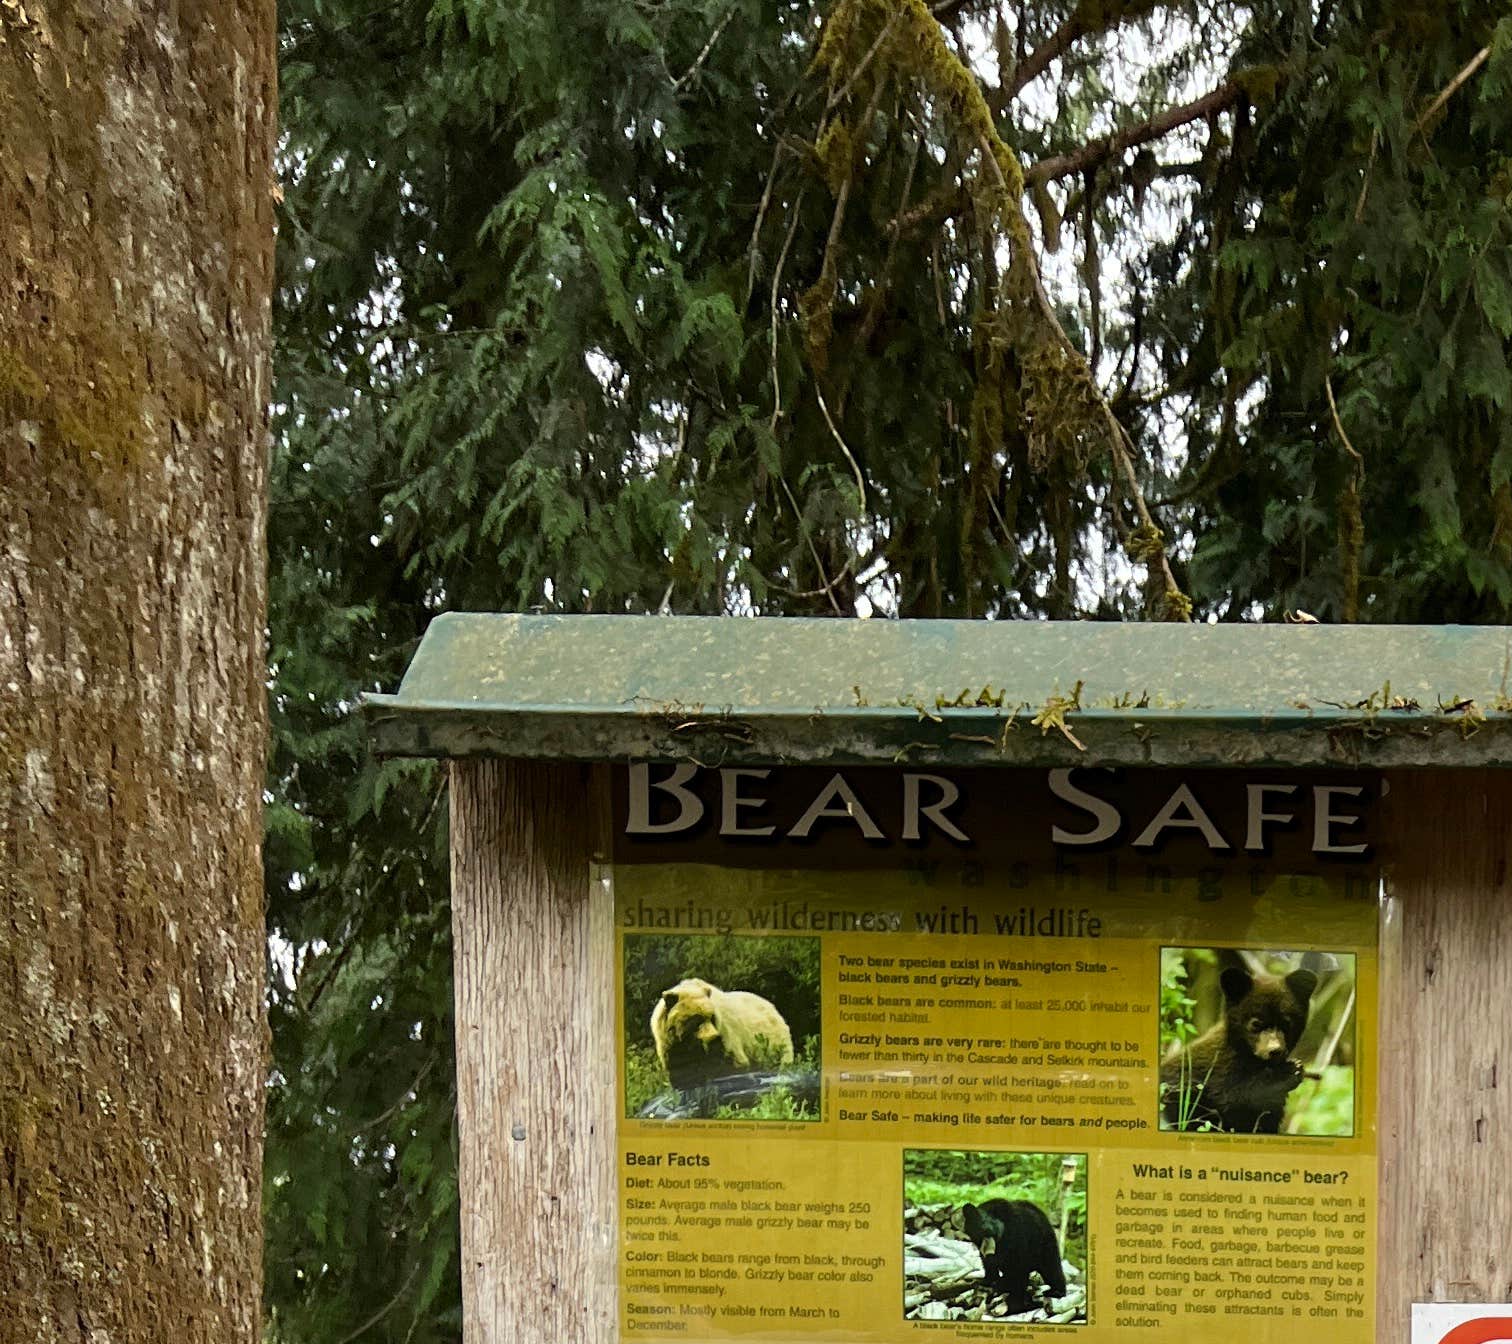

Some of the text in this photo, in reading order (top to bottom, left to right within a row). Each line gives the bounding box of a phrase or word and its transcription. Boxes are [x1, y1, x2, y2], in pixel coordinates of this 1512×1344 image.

[624, 764, 1368, 854] BEAR SAFE
[623, 901, 1102, 937] sharing wilderness with wildlife
[838, 954, 864, 967] Two
[867, 955, 895, 967] bear
[898, 957, 946, 970] species
[949, 957, 980, 970] exist
[983, 958, 995, 970] in
[997, 958, 1071, 974] Washington
[1075, 960, 1107, 973] State
[838, 971, 1022, 988] black bears and grizzly bears.
[839, 1109, 867, 1120] Bear
[871, 1109, 898, 1121] Safe
[913, 1112, 958, 1126] making
[962, 1112, 981, 1124] life
[985, 1113, 1015, 1125] safer
[1019, 1114, 1036, 1125] for
[1040, 1115, 1075, 1126] bears
[1078, 1116, 1103, 1127] and
[1105, 1117, 1150, 1130] people.
[625, 1152, 710, 1166] Bear Facts
[1132, 1163, 1348, 1184] What is a “nuisance” bear?
